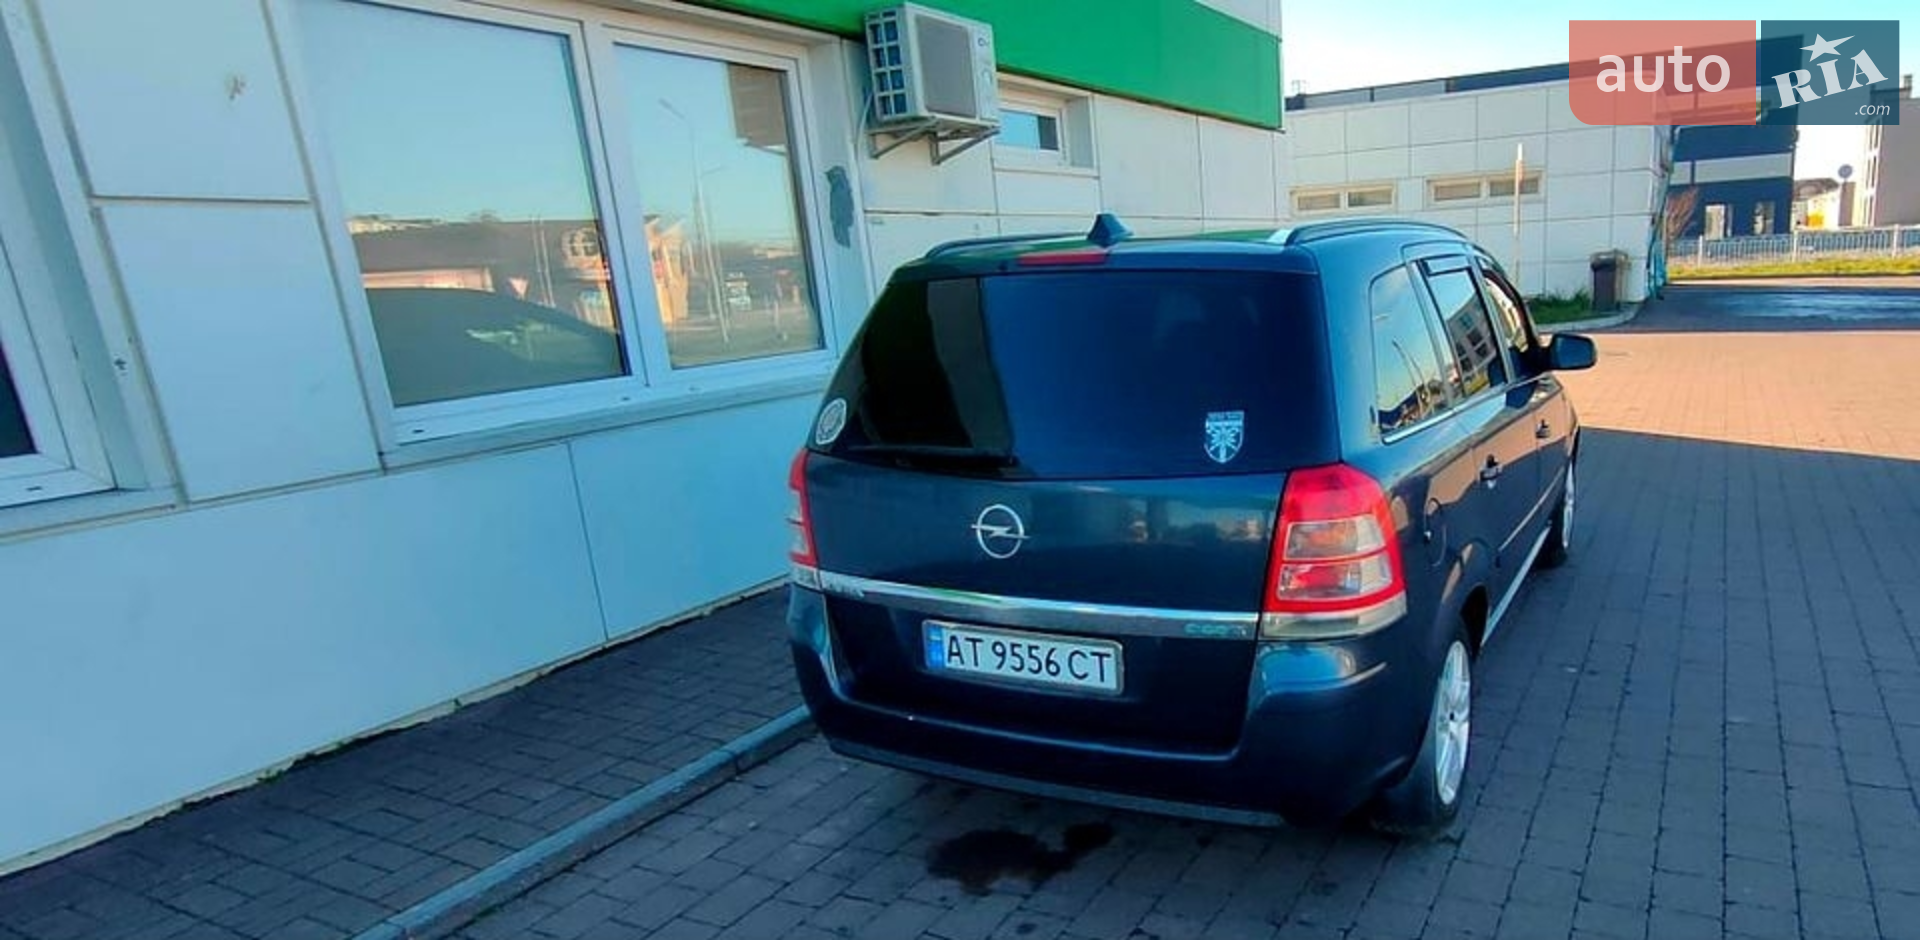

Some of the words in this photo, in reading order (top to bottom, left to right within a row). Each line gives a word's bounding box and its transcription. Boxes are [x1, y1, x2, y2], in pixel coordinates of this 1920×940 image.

[947, 635, 984, 668] AT
[991, 641, 1061, 677] 9556
[1067, 650, 1112, 683] CT
